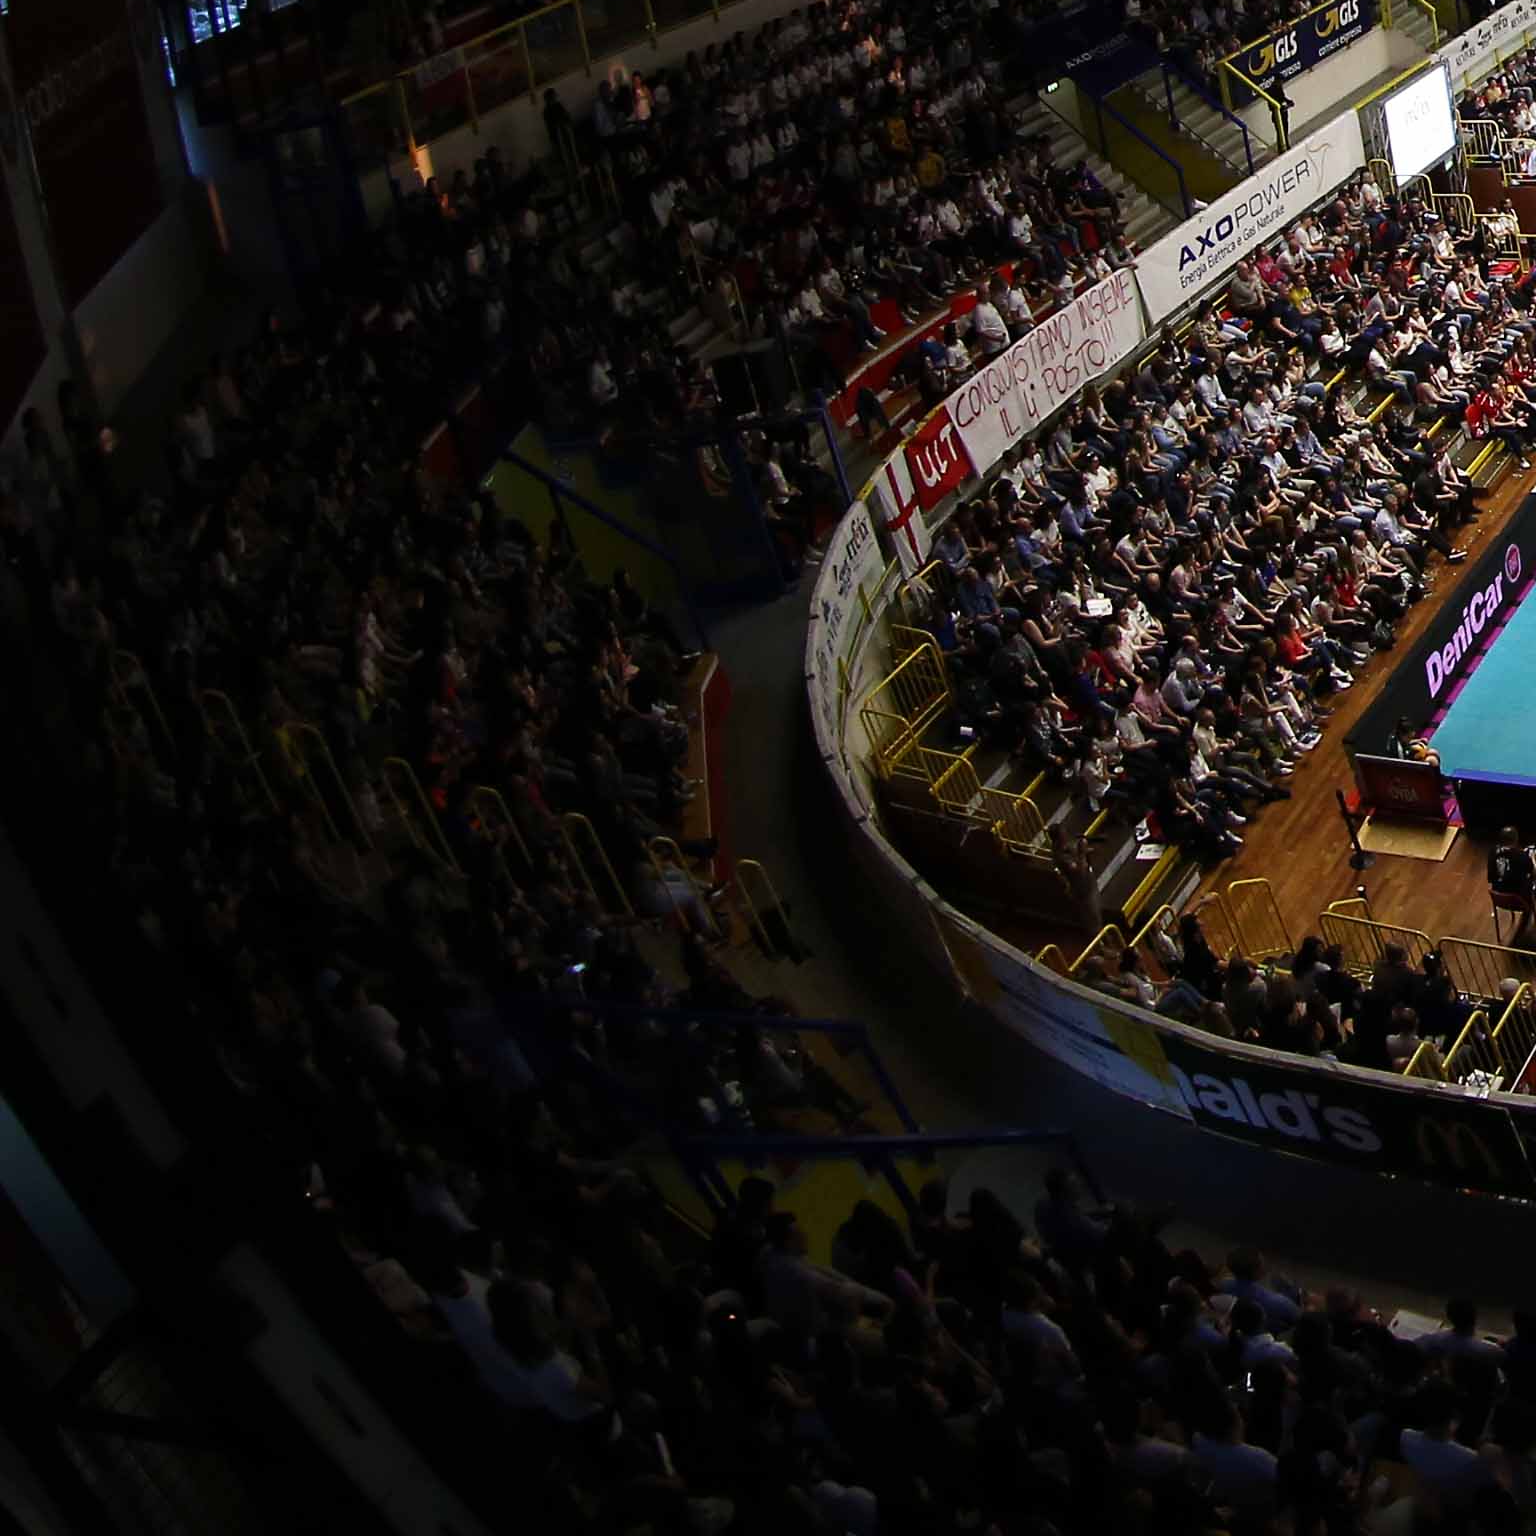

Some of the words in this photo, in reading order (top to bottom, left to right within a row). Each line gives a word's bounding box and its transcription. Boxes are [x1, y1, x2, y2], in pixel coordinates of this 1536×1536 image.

[1275, 31, 1298, 63] GLS
[1179, 159, 1311, 272] AXOPOWER
[1180, 265, 1207, 289] Energia
[1207, 241, 1236, 268] Elettrica
[1243, 228, 1256, 242] Gas
[1257, 206, 1285, 230] Naturale
[1076, 272, 1133, 331] INSIEME
[1000, 408, 1021, 439] IL
[1425, 575, 1504, 699] DeniCar
